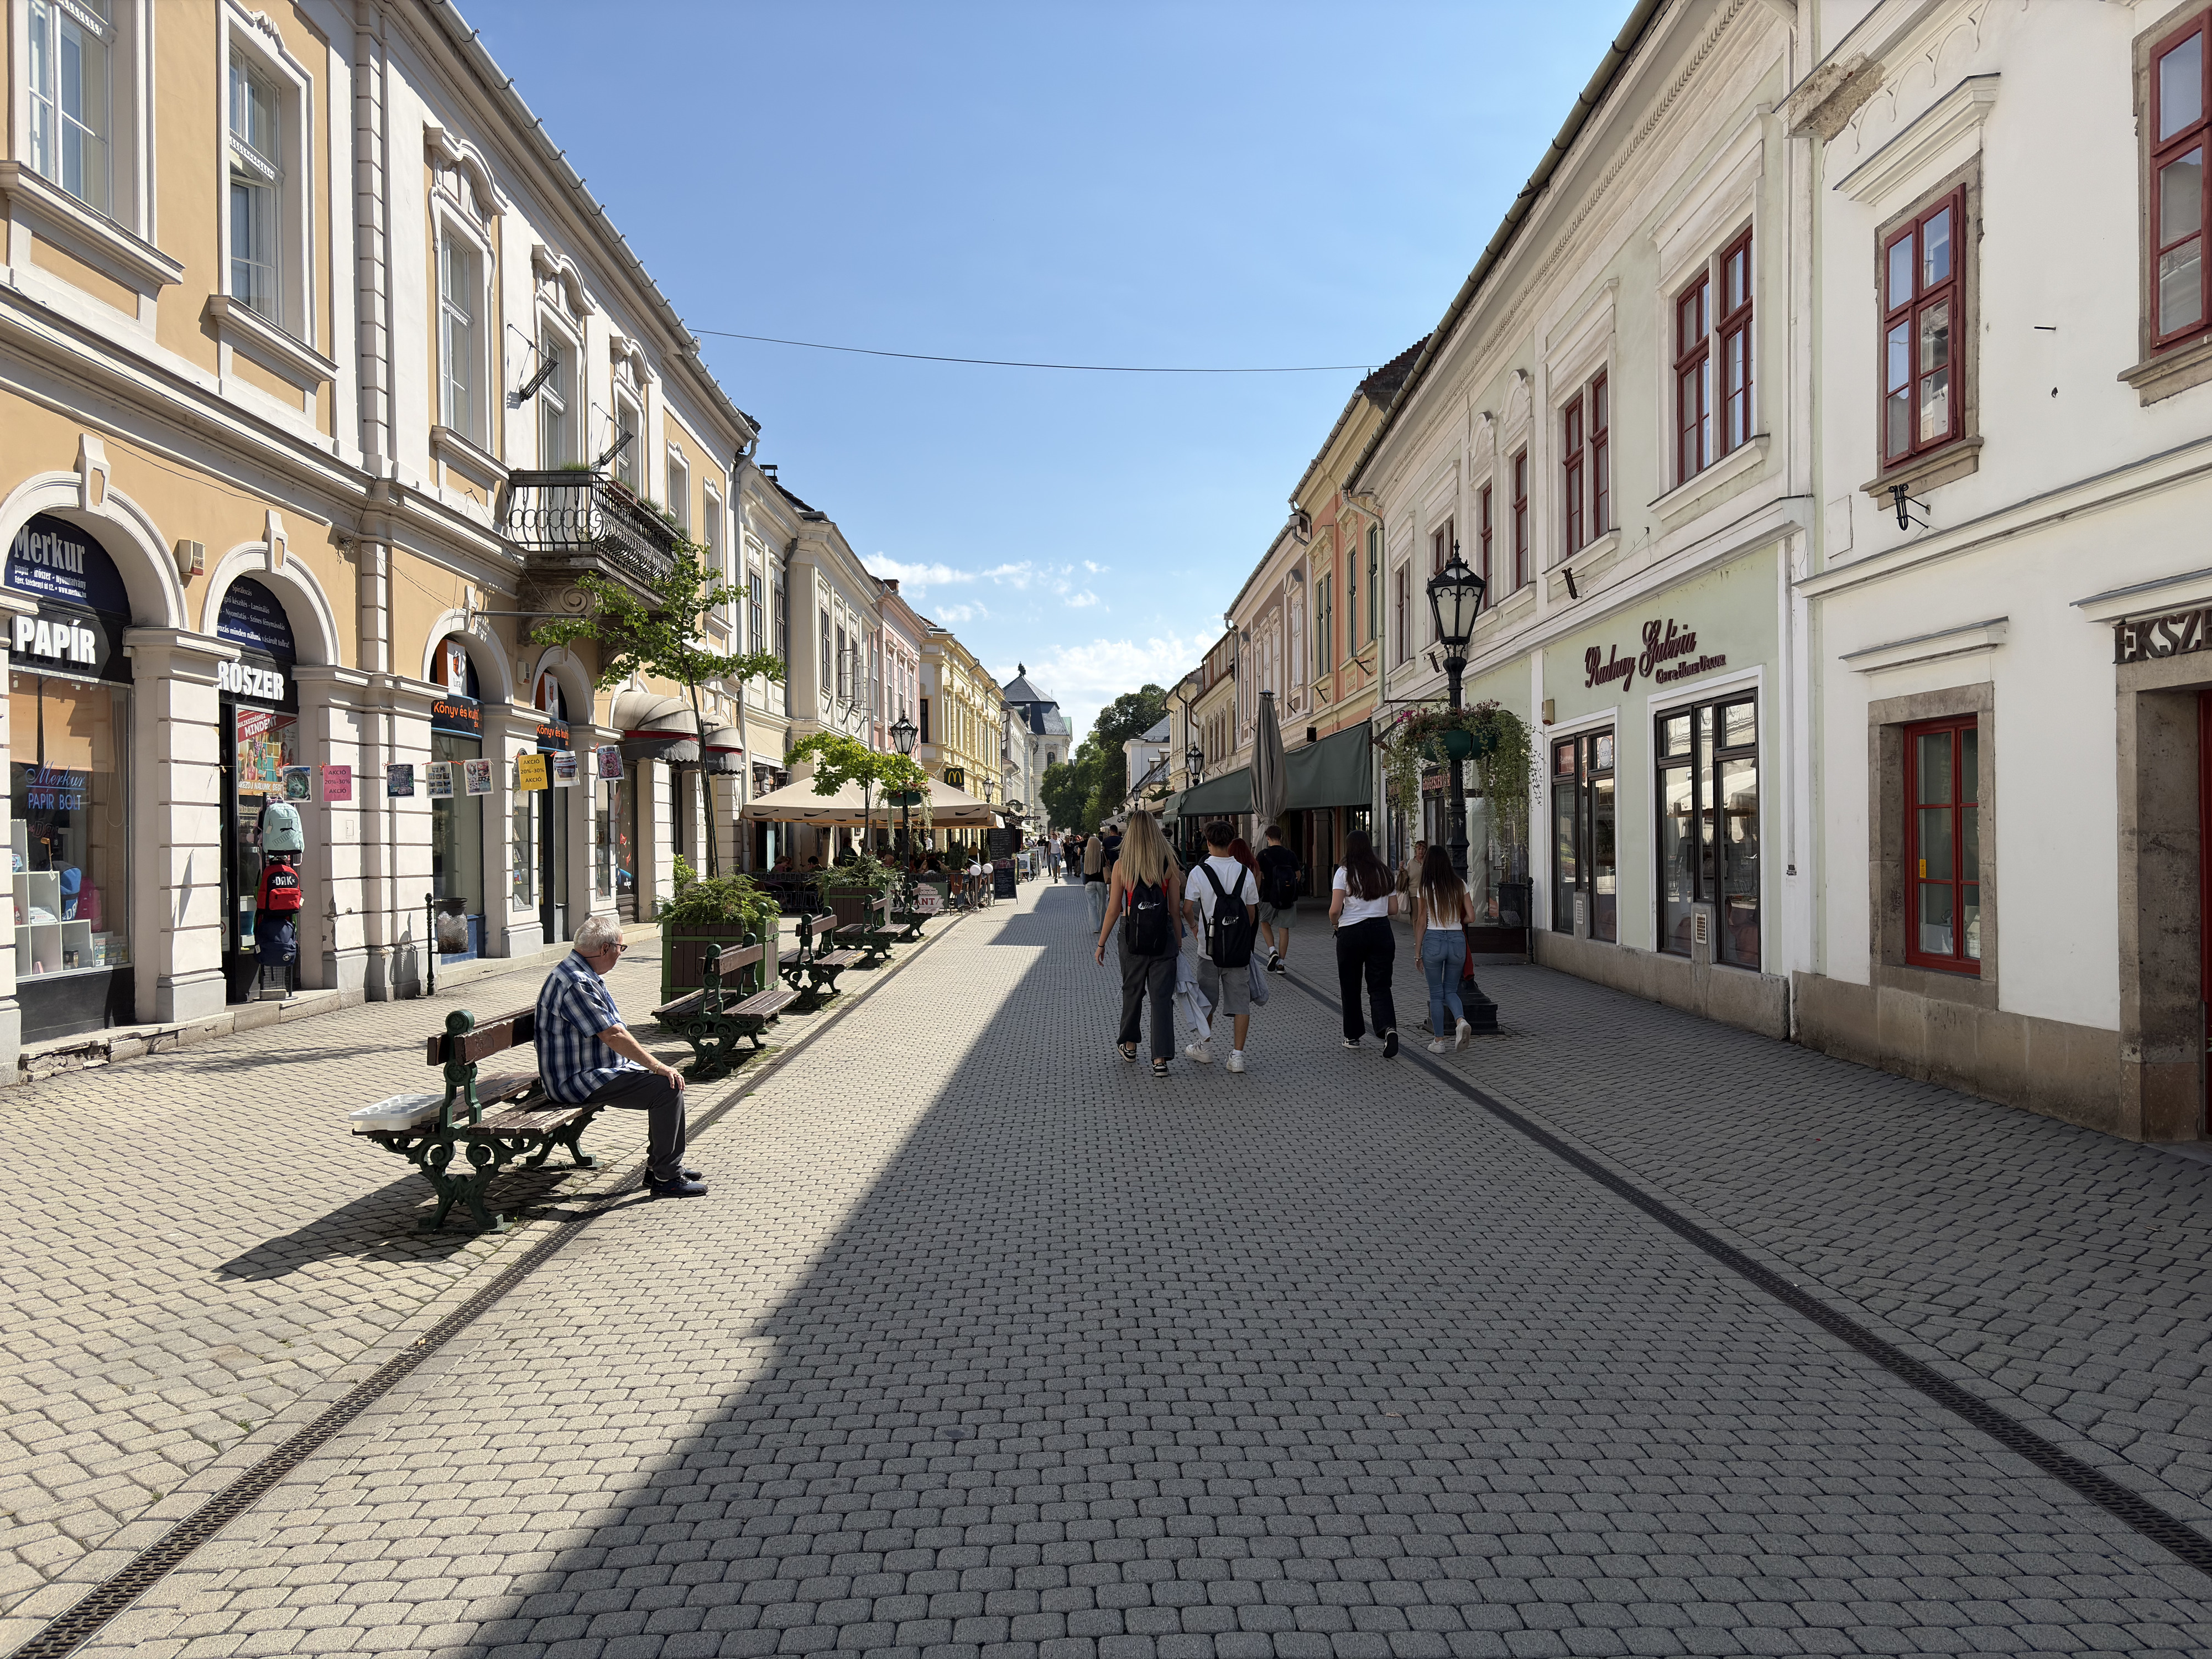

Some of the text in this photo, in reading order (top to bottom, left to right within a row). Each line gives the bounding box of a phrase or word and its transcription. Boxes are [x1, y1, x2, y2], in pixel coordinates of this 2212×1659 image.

[14, 525, 85, 574] Merkur
[14, 565, 29, 576] papír
[34, 568, 51, 581] írószer
[232, 585, 252, 596] Spirálozás
[226, 608, 247, 620] Nyomtatás
[232, 597, 248, 608] készítés
[251, 603, 270, 614] Laminálás
[15, 615, 96, 664] PAPÍR
[230, 628, 247, 638] minden
[247, 631, 262, 641] nálunk
[1639, 619, 1697, 677] Galéria
[218, 658, 284, 701] RÓSZER
[453, 677, 461, 688] Lira
[434, 701, 458, 718] Könyv
[460, 705, 467, 718] és
[244, 716, 276, 737] MINDENT
[536, 724, 554, 738] Könyv
[555, 726, 561, 737] és
[25, 760, 86, 787] Merkur
[28, 788, 81, 810] PAPÍR BOLT
